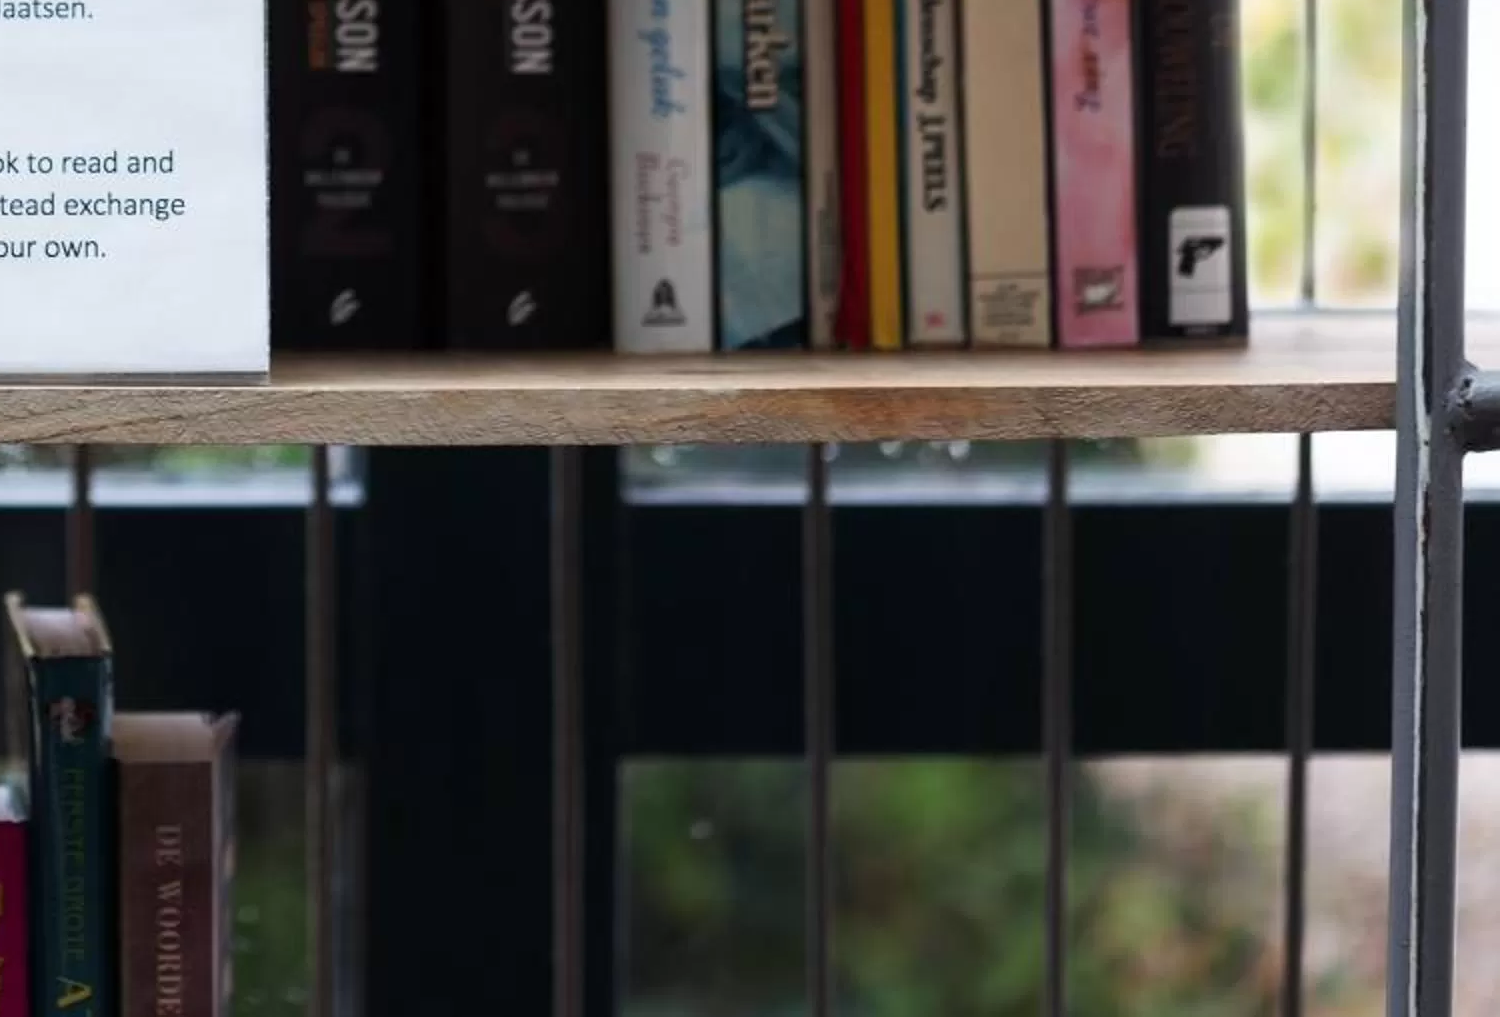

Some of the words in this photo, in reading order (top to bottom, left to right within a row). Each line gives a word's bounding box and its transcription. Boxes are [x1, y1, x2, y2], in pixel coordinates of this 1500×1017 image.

[26, 152, 54, 175] to
[61, 149, 119, 175] read
[126, 149, 175, 175] and
[63, 190, 187, 222] exchange
[43, 239, 107, 259] own.
[154, 823, 183, 867] DE
[155, 879, 183, 1017] WOORDE
